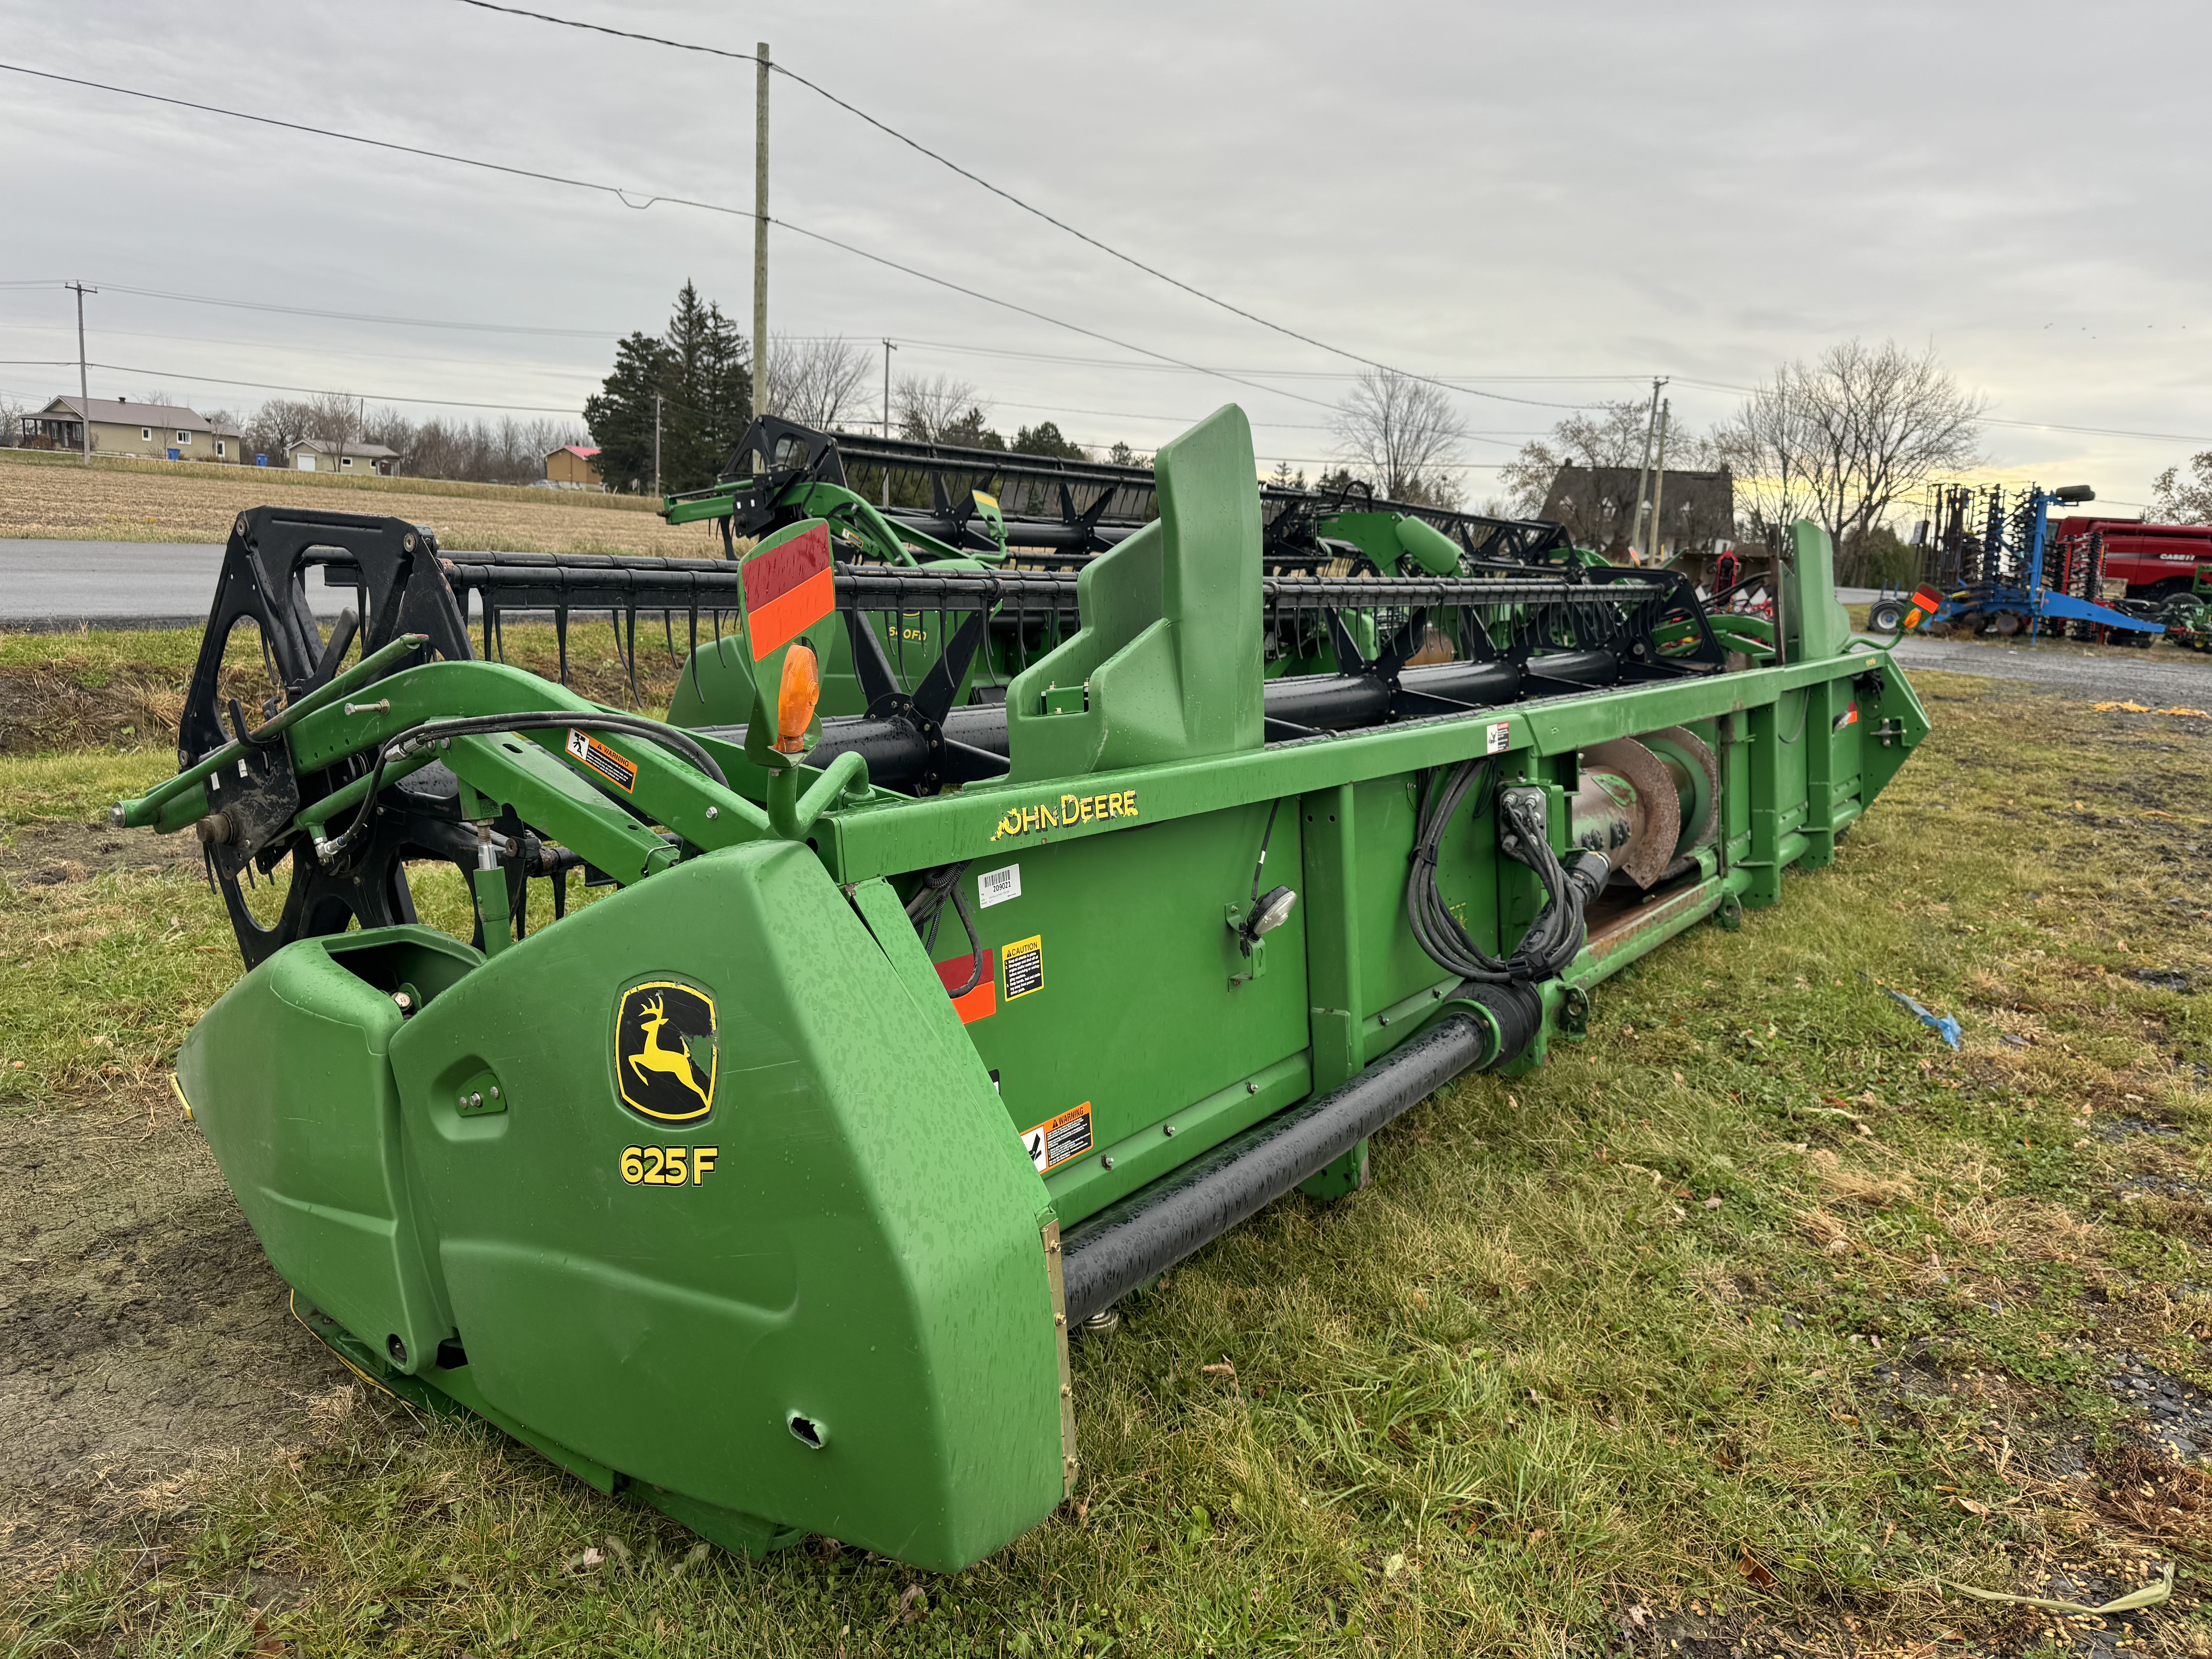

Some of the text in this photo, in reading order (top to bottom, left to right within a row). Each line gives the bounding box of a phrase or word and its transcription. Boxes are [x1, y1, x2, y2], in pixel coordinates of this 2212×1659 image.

[604, 746, 629, 768] WARNING
[1060, 790, 1139, 826] DEERE
[993, 881, 1011, 892] 209021
[1012, 941, 1038, 956] CAUTION
[1058, 1106, 1084, 1126] WARNING
[621, 1145, 718, 1186] 625F
